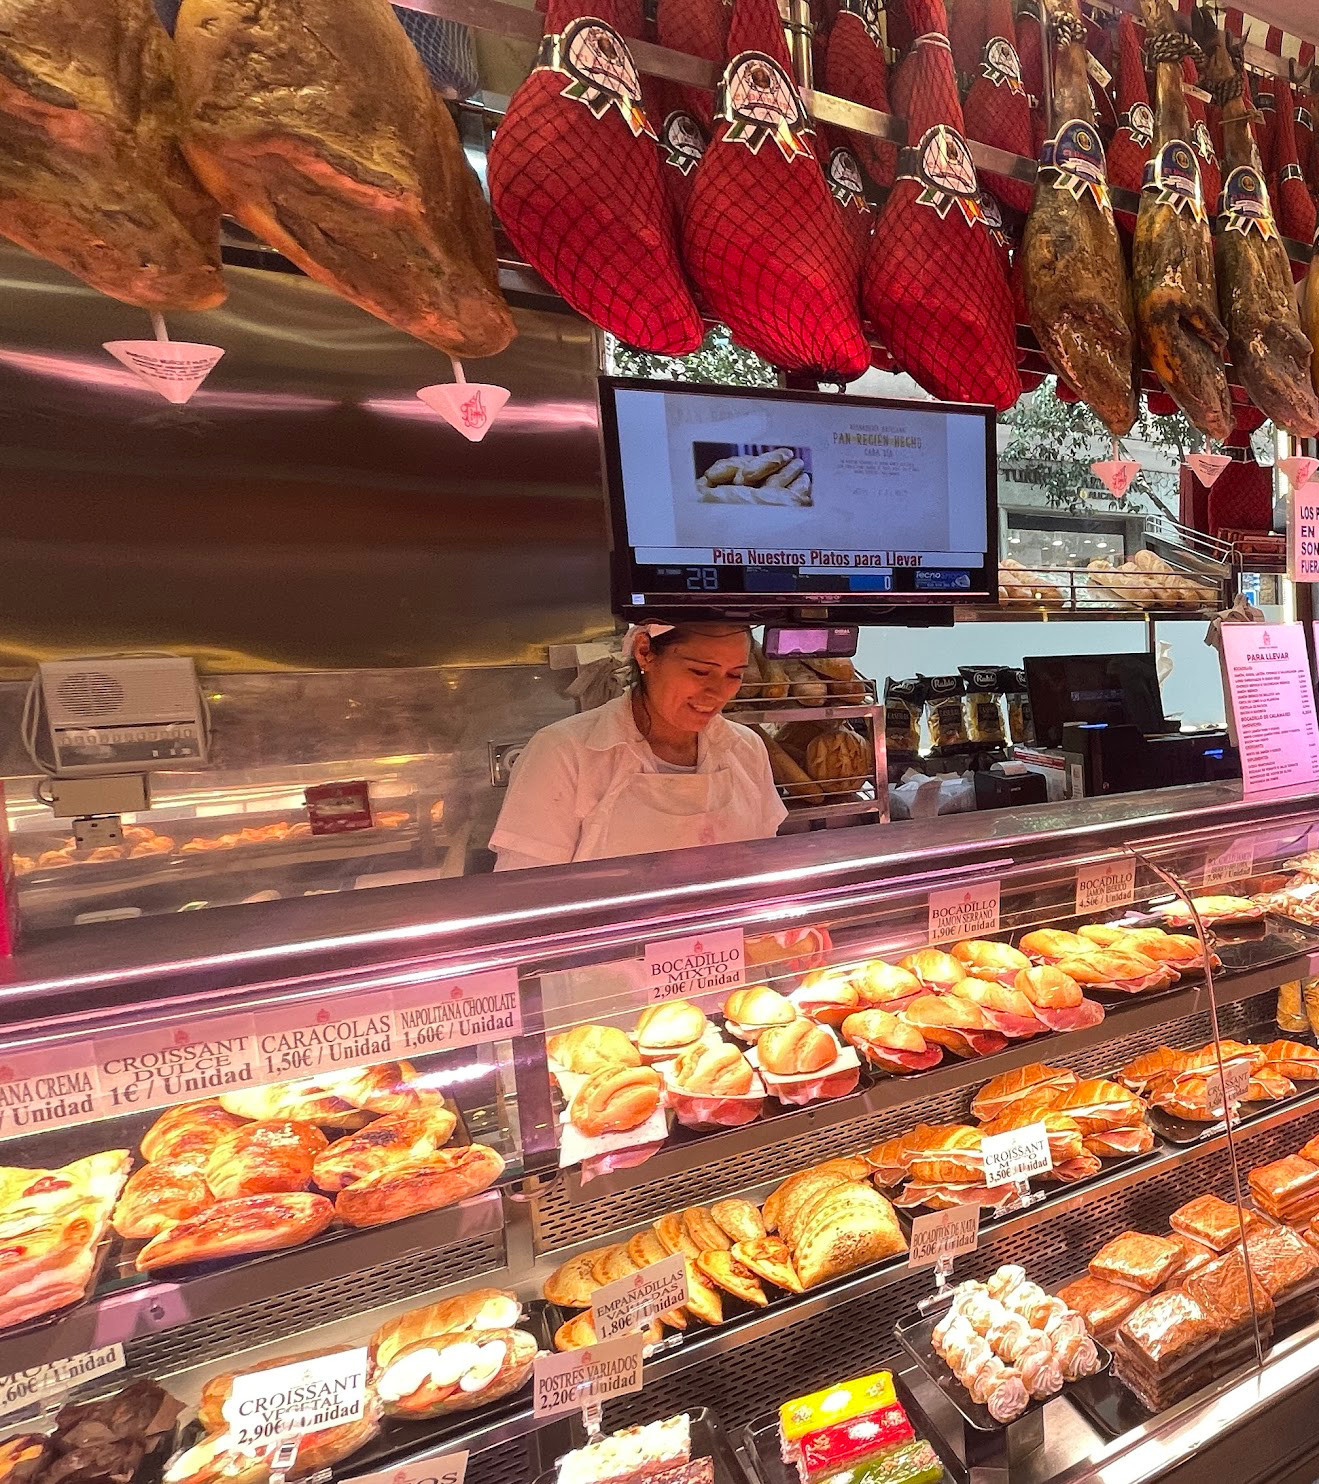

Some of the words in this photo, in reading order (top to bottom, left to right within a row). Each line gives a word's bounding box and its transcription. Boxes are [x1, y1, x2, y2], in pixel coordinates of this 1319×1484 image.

[1300, 506, 1314, 520] LOS
[1300, 525, 1316, 538] EN
[712, 548, 743, 564] Pida
[747, 549, 806, 566] Nuestros
[809, 550, 851, 566] Platos
[854, 552, 882, 568] para
[885, 552, 924, 567] Llevar
[1300, 541, 1319, 556] SON
[686, 567, 719, 590] 28
[1246, 652, 1265, 662] PARA
[1265, 651, 1289, 661] LLEVAR
[1079, 872, 1133, 891] BOCADILLO
[1105, 889, 1132, 903] Unidad
[931, 898, 998, 920] BOCADILLO
[937, 912, 963, 928] JAMON
[962, 909, 994, 926] SERRANO
[931, 924, 957, 940] 1,90€
[964, 917, 997, 932] Unidad
[650, 947, 740, 977] BOCADILLO
[667, 962, 729, 984] MIXTO
[653, 980, 687, 999] 2,90€
[697, 971, 741, 990] Unidad
[400, 1001, 462, 1030] NAPOLITANA
[461, 991, 518, 1020] CHOCOLATE
[260, 1014, 391, 1054] CARACOLAS
[402, 1024, 446, 1048] 1,60€
[459, 1012, 515, 1037] Unidad
[103, 1036, 249, 1076] CROISSANT
[133, 1055, 232, 1084] DULCE
[266, 1050, 314, 1075] 1,50€
[328, 1035, 392, 1062] Unidad
[35, 1071, 94, 1101] CREMA
[109, 1083, 140, 1107] 1€
[146, 1079, 155, 1100] /
[163, 1062, 253, 1096] Unidad
[13, 1093, 94, 1127] Unidad
[985, 1139, 1046, 1167] CROISSANT
[989, 1168, 1012, 1184] 3,50€
[1017, 1157, 1049, 1174] Unidad
[912, 1242, 937, 1261] 0,50€
[944, 1232, 976, 1251] Unidad
[596, 1269, 685, 1319] EMPANADILLAS
[600, 1315, 633, 1340] 1,80€
[643, 1288, 685, 1318] Unidad
[538, 1368, 585, 1395] POSTRES
[586, 1353, 638, 1379] VARIADOS
[238, 1373, 362, 1417] CROISSANT
[540, 1388, 577, 1411] 2,20€
[588, 1370, 637, 1397] Unidad
[238, 1419, 286, 1445] 2,90€
[300, 1399, 360, 1428] Unidad
